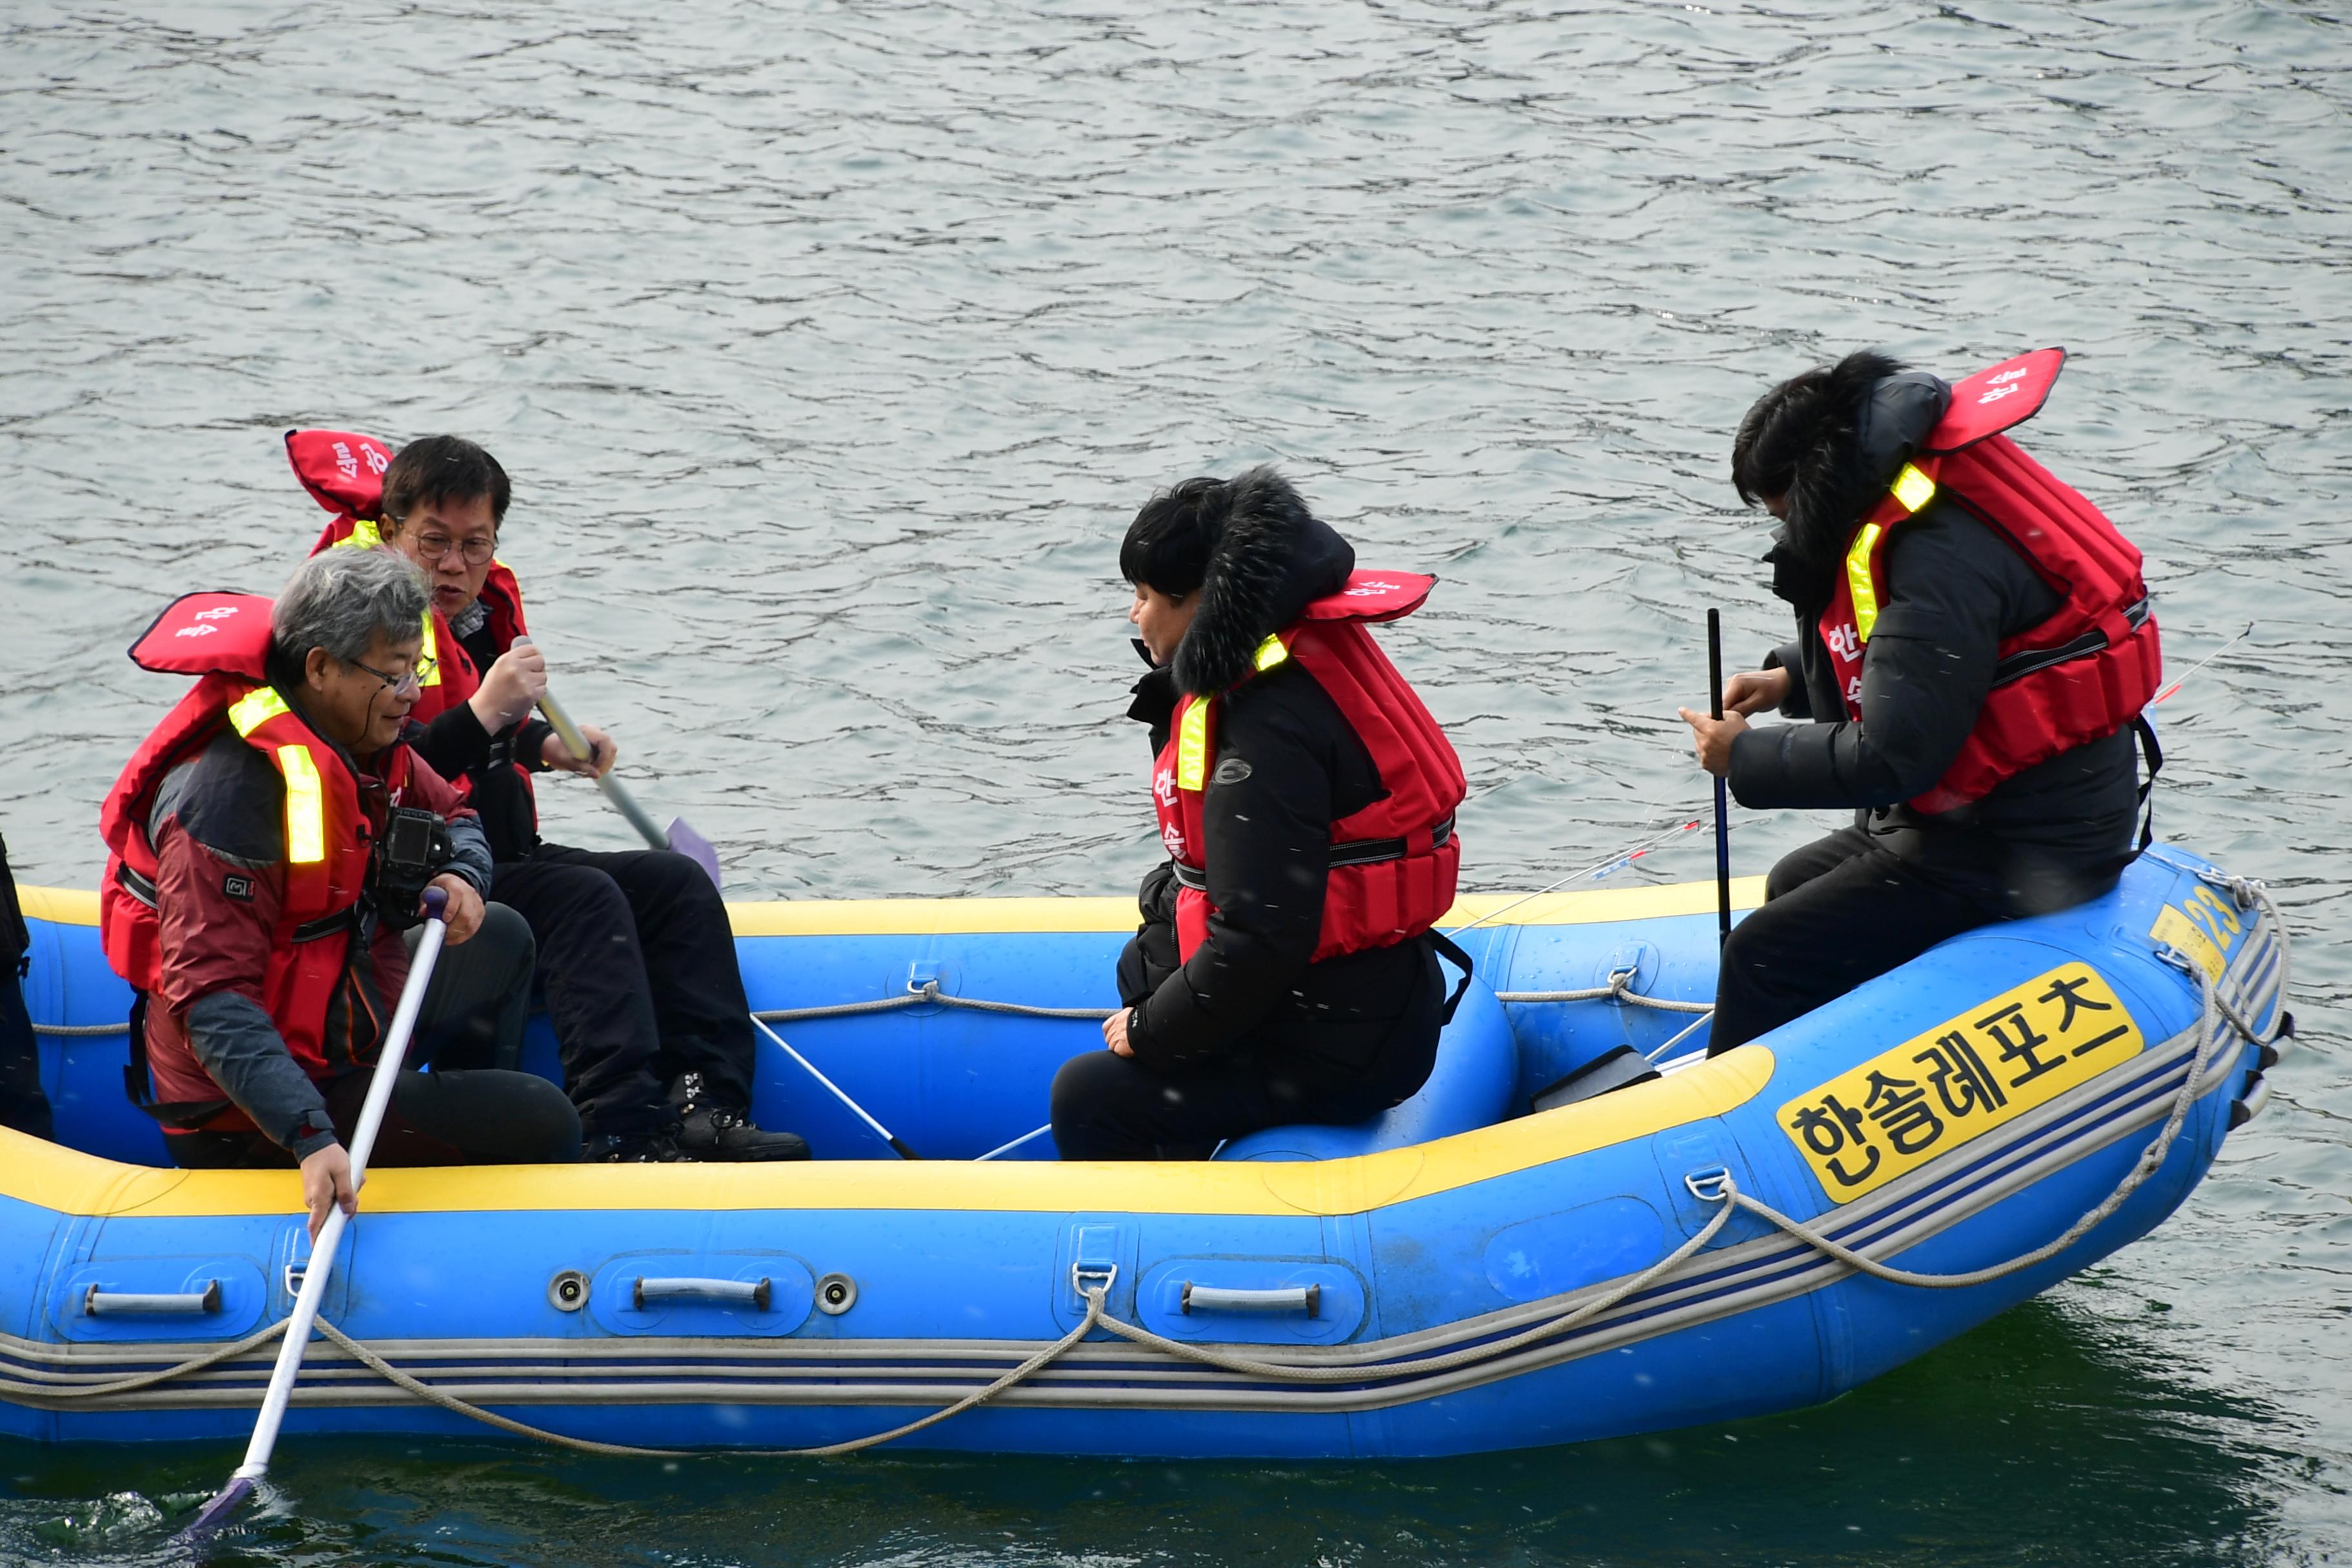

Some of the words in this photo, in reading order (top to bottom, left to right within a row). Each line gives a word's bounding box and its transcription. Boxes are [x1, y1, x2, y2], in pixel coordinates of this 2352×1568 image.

[1977, 368, 2027, 405] 한솔
[1344, 581, 1401, 596] 한솔
[175, 606, 239, 638] 한솔
[2183, 885, 2242, 952] 23
[1790, 976, 2130, 1187] 한솔레포츠
